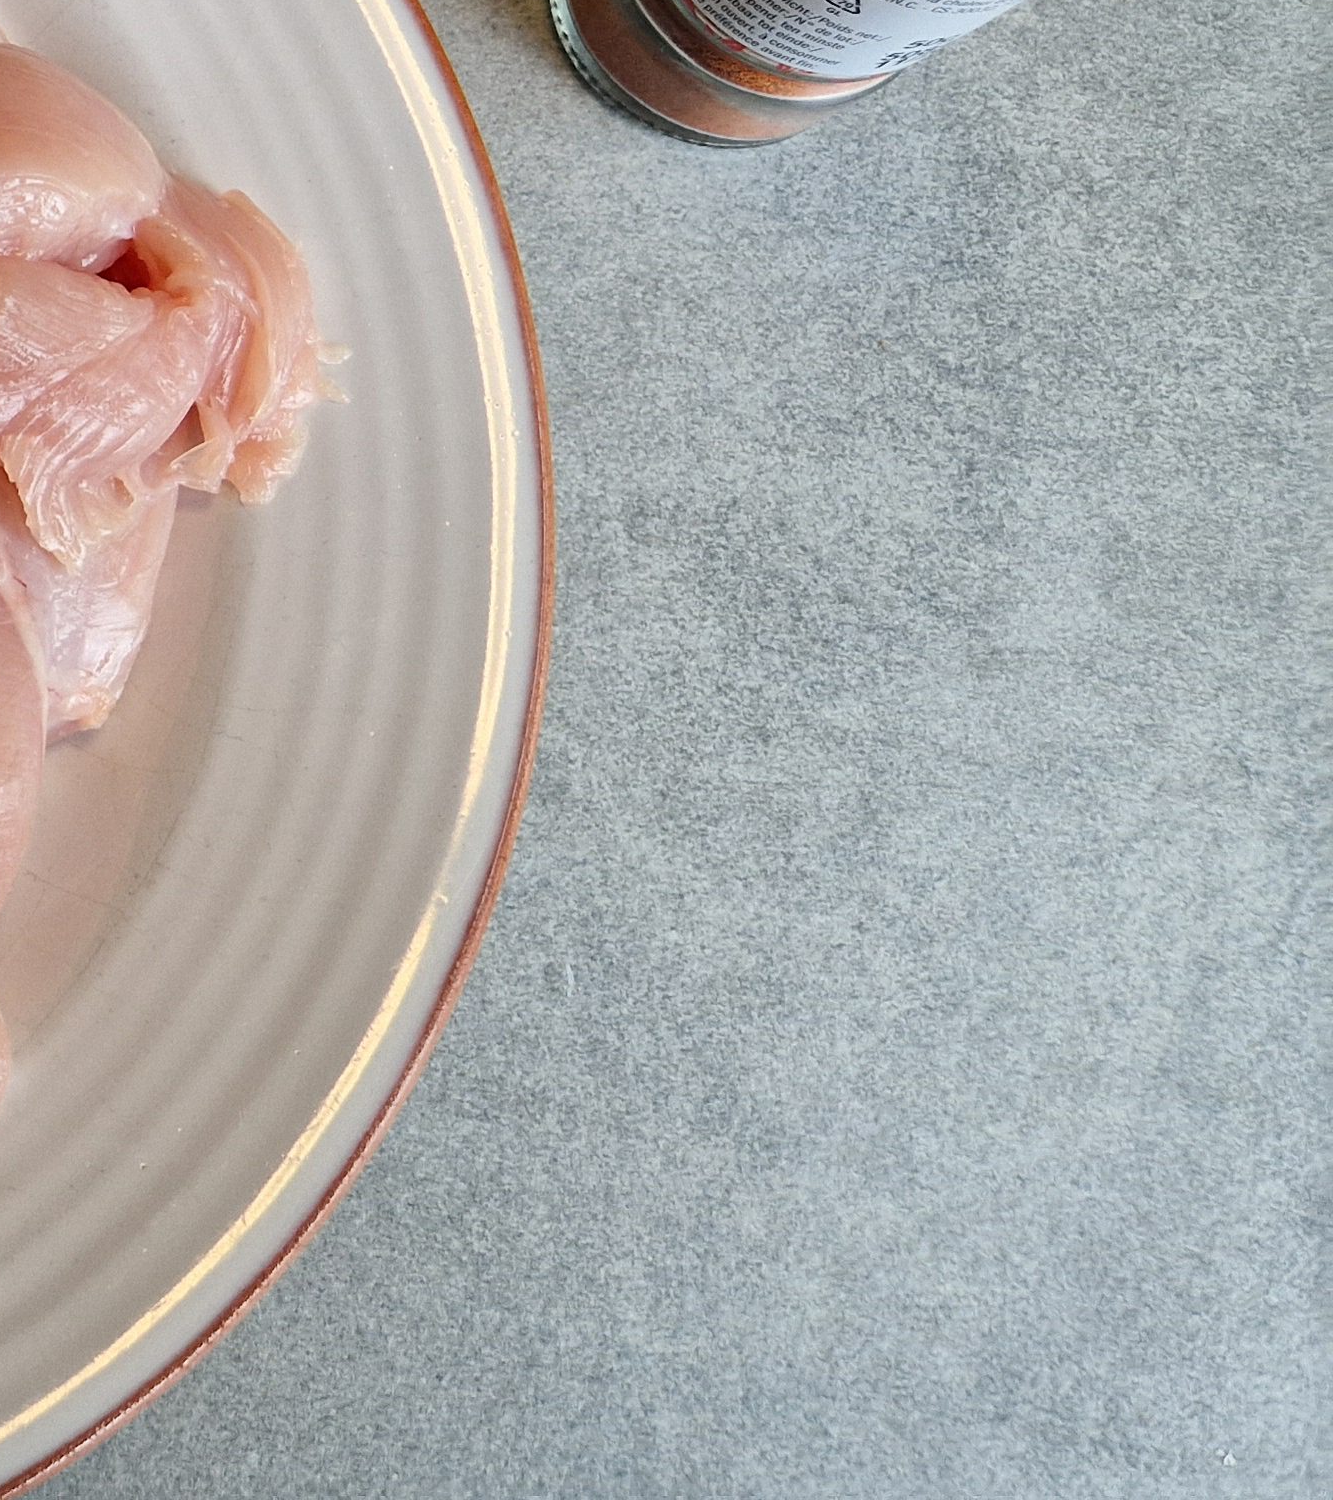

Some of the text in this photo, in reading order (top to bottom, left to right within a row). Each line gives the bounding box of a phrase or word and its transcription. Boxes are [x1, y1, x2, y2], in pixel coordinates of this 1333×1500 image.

[703, 4, 761, 50] préférence
[760, 45, 796, 64] avant
[757, 18, 776, 33] tot
[780, 20, 801, 34] ten
[801, 32, 846, 51] minste
[814, 27, 833, 37] de
[769, 38, 842, 66] consommer
